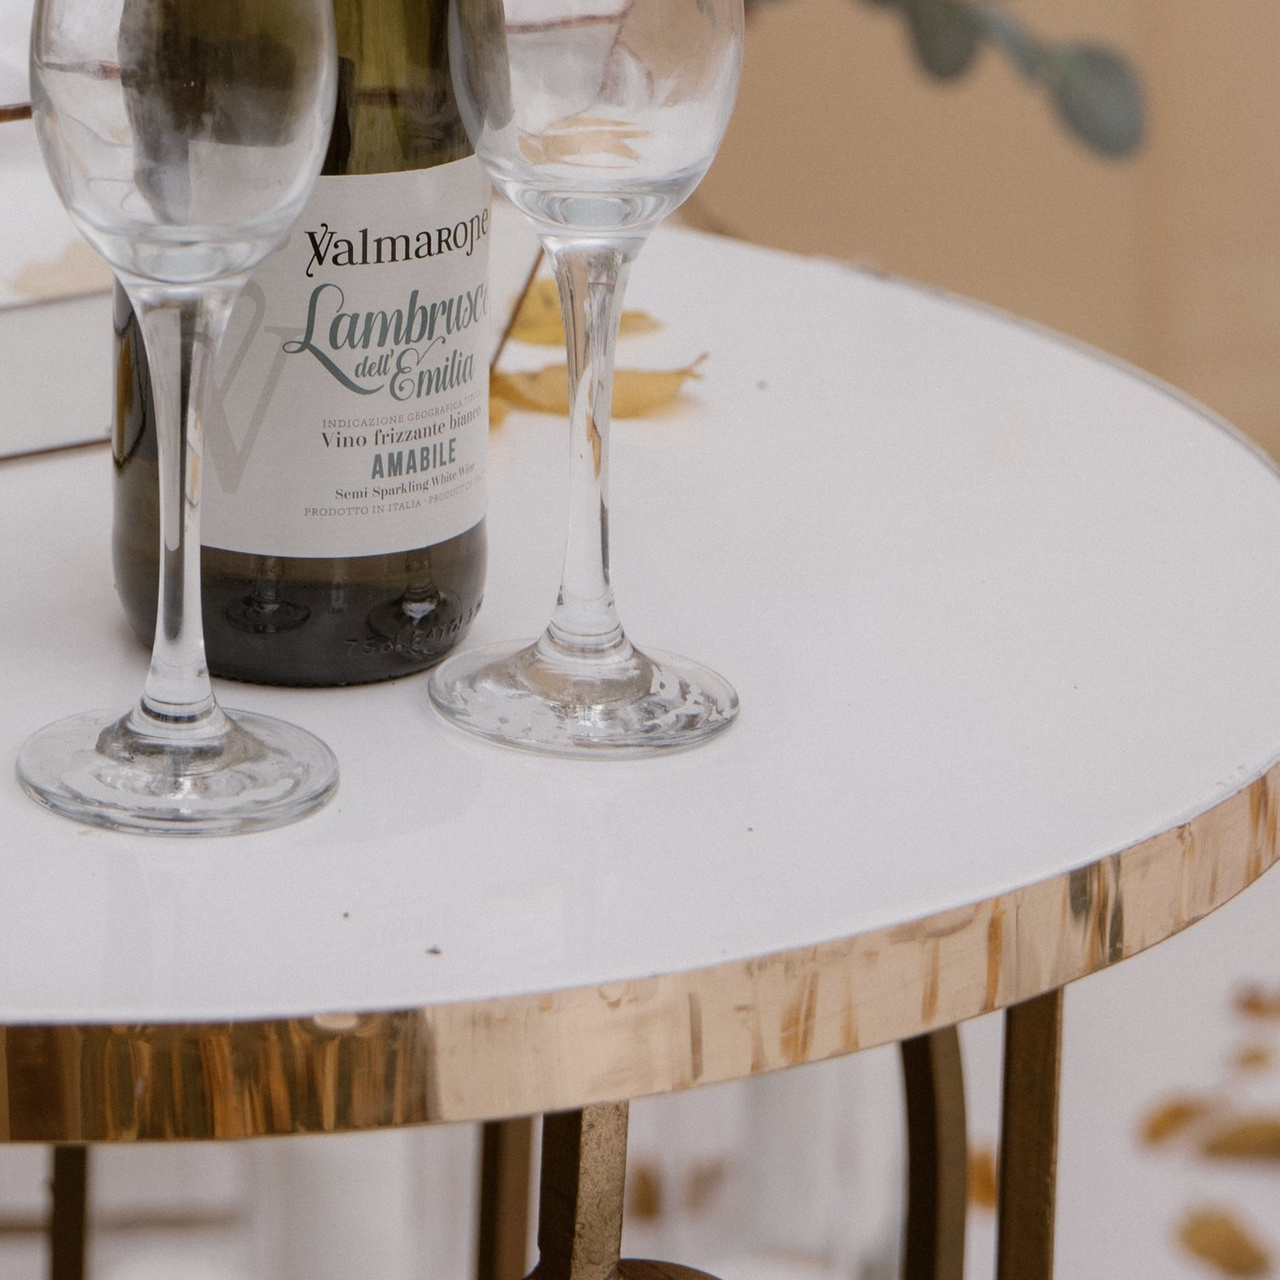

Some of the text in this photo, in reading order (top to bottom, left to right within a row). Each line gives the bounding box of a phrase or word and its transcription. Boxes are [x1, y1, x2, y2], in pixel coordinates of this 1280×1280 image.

[321, 404, 482, 448] Vino frizzante bianco
[322, 414, 404, 429] INDICAZIONE
[407, 400, 463, 422] GEOGRAFICA
[371, 438, 457, 480] AMABILE
[334, 487, 368, 500] Semi
[372, 479, 429, 500] Sparkling
[431, 471, 458, 486] White
[304, 506, 369, 517] PRODOTTO
[372, 505, 386, 514] IN
[388, 499, 422, 513] ITALIA
